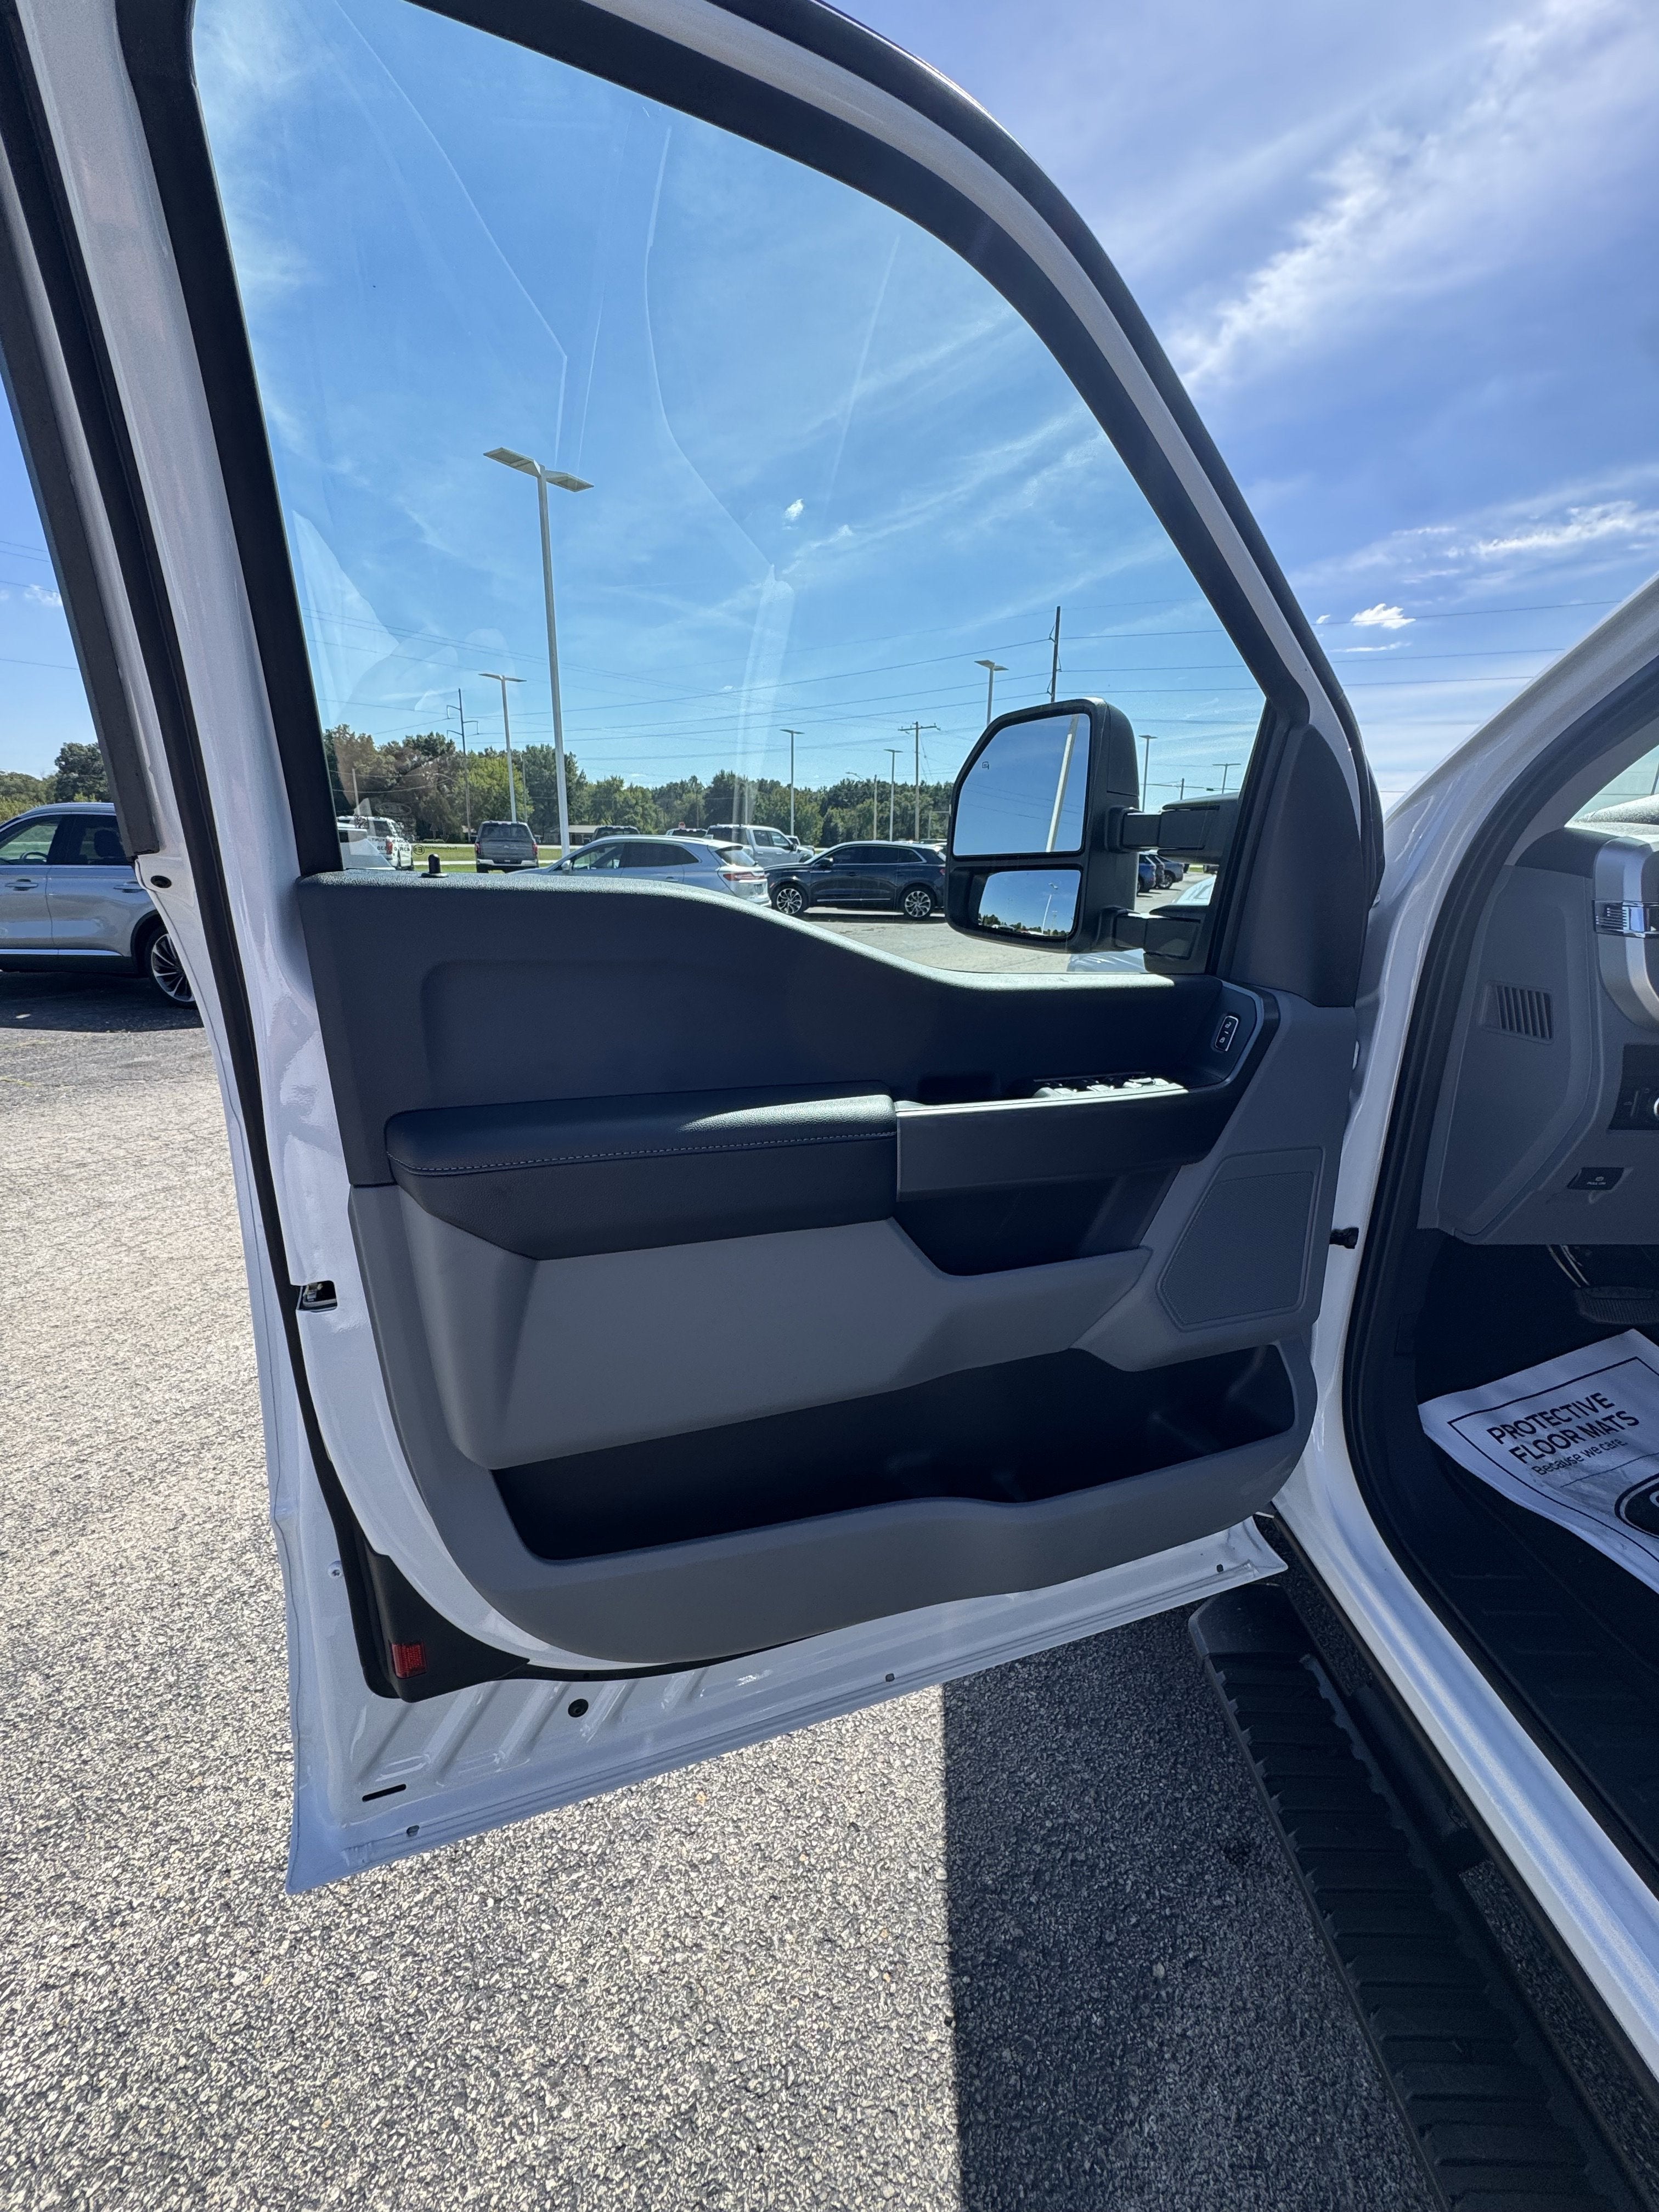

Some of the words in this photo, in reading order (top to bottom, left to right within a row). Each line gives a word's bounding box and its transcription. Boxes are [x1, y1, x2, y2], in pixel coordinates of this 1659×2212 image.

[1486, 1392, 1615, 1444] PROTECTIVE
[1509, 1429, 1586, 1464] FLOOR
[1576, 1410, 1639, 1438] MATS
[1531, 1453, 1584, 1475] Because
[1582, 1446, 1601, 1458] we
[1599, 1438, 1628, 1451] care.
